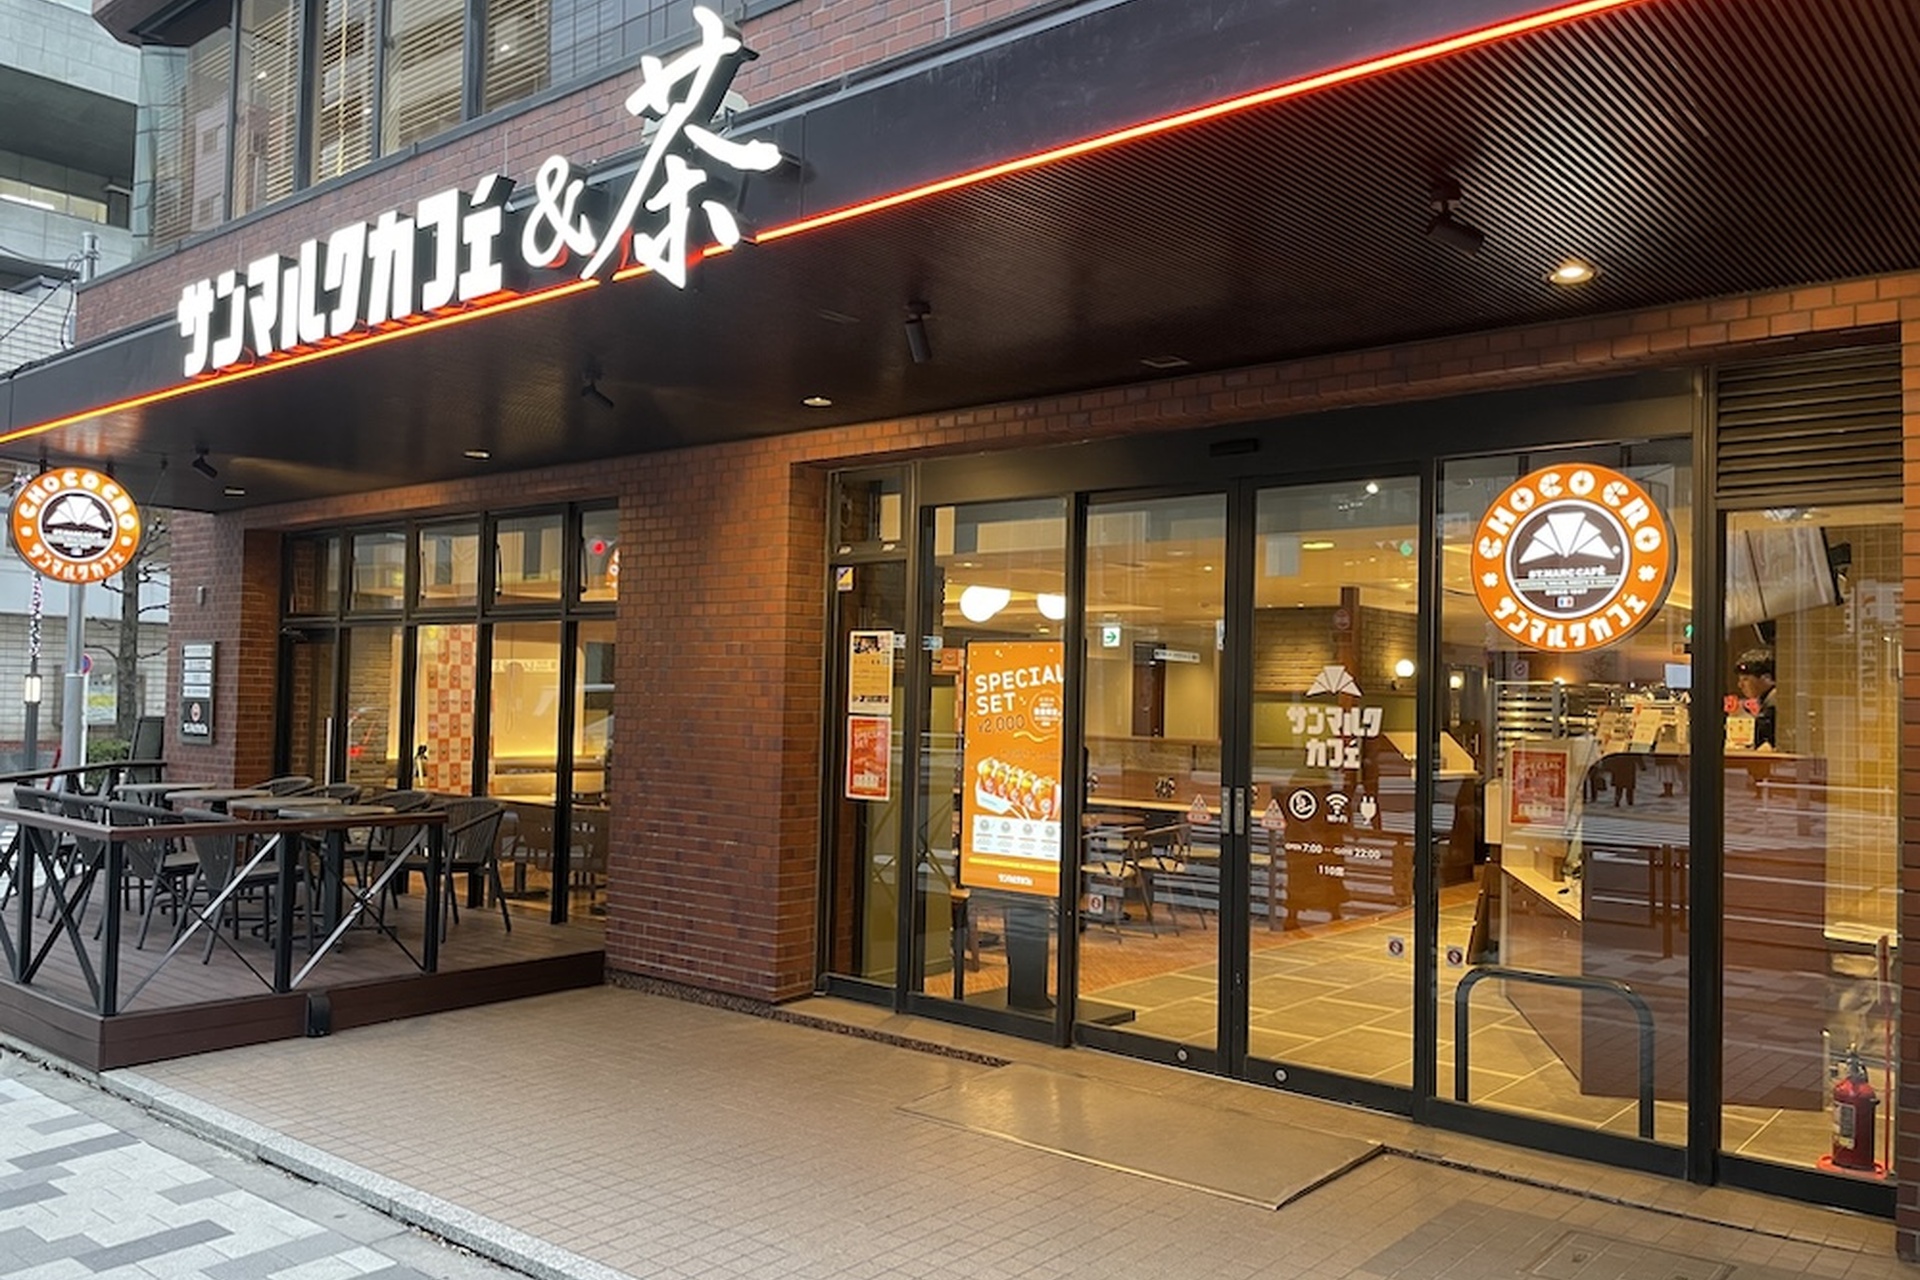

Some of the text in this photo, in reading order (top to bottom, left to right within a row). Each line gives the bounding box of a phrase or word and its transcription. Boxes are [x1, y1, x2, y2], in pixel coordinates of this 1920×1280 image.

[178, 6, 782, 378] サンマルクカフェ & 茶
[1478, 470, 1662, 560] CHOCOCRO
[1493, 593, 1648, 648] サンマルクカフェ
[974, 663, 1064, 694] SPECIAL
[976, 692, 1016, 715] SET
[1286, 706, 1383, 737] サンマルク
[1305, 737, 1361, 769] カフェ
[1302, 842, 1324, 854] 7:00
